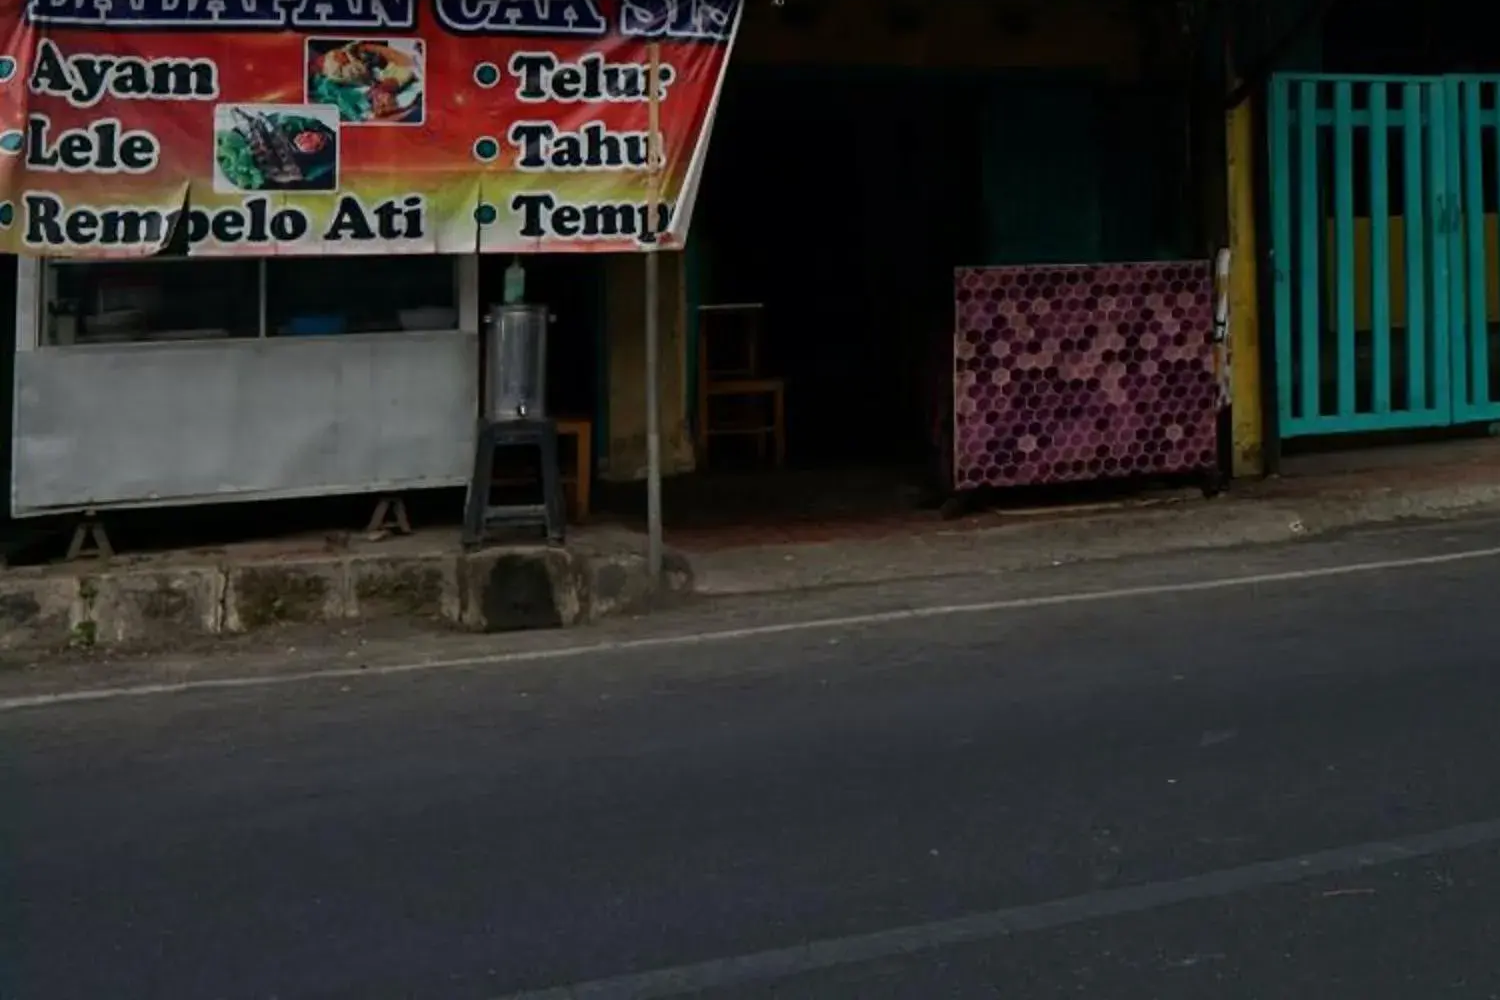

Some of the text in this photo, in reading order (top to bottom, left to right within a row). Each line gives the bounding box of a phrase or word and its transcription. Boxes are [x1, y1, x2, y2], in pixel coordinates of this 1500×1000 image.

[30, 40, 216, 103] Ayam
[511, 54, 673, 101] Telur
[27, 115, 158, 171] Lele
[510, 123, 664, 171] Tahu
[24, 194, 424, 246] Rempelo Ati
[511, 194, 676, 244] Temp
